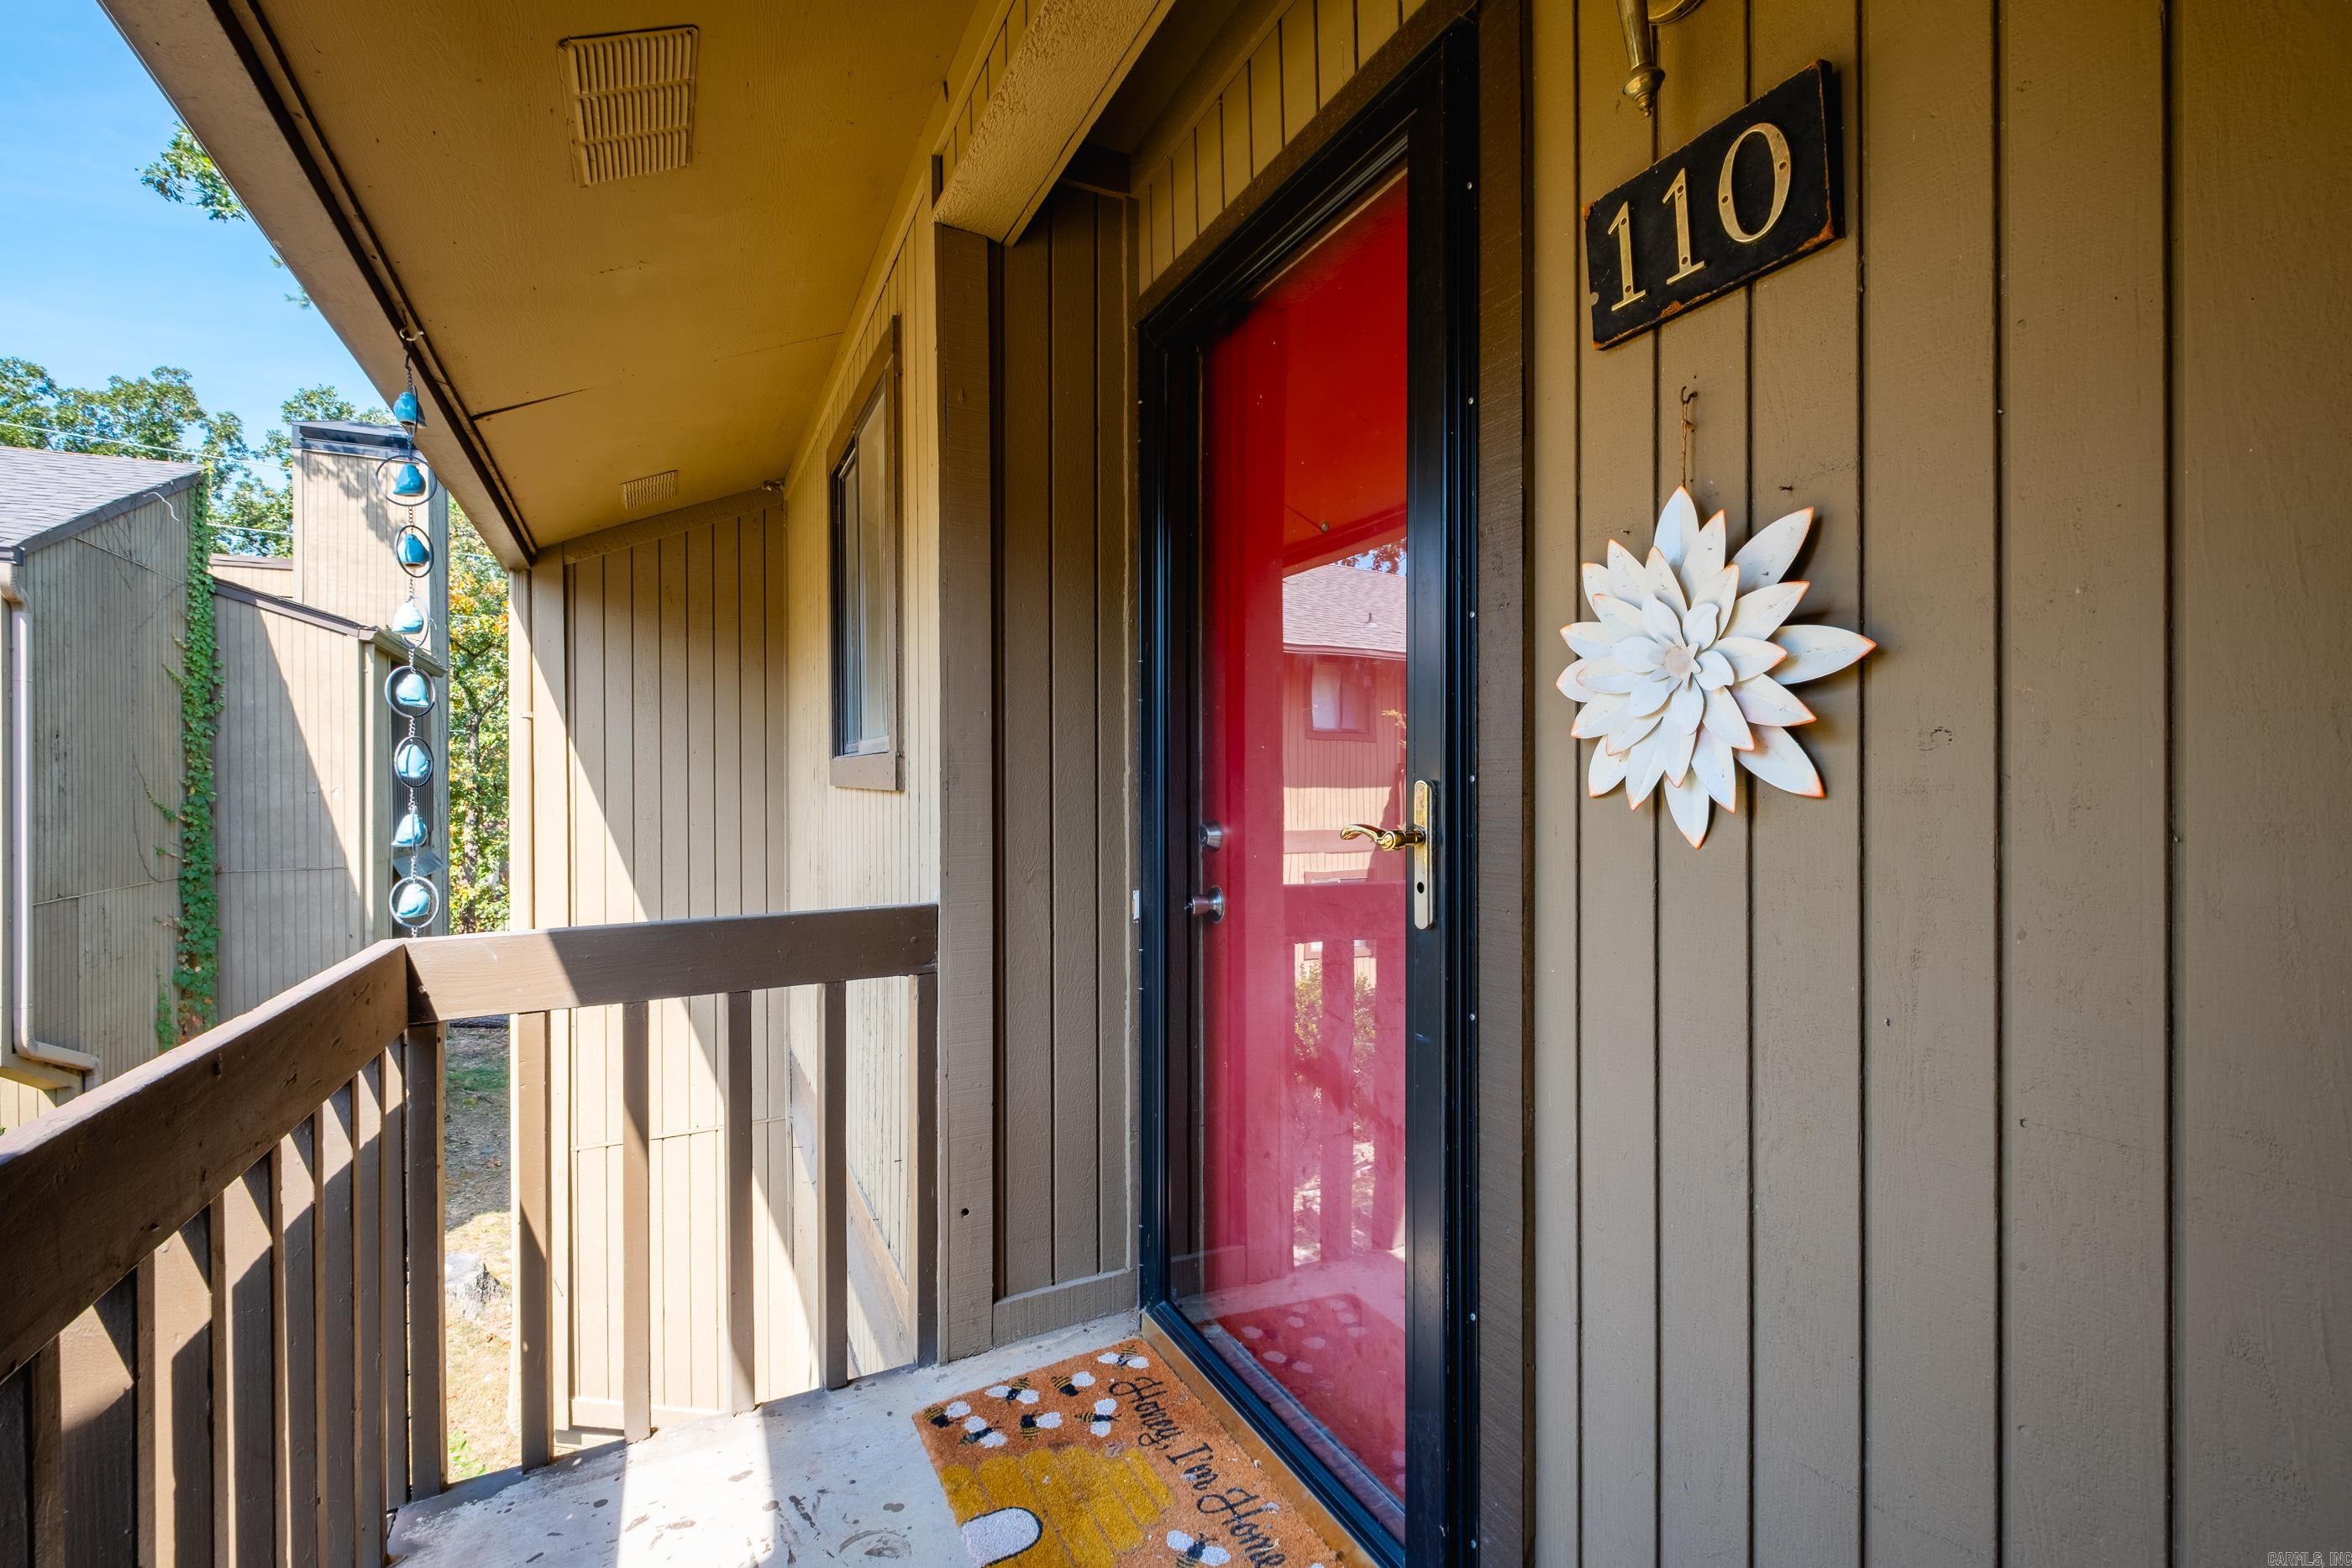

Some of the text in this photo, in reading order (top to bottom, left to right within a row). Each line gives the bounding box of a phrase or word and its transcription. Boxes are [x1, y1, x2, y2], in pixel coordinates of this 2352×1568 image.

[1608, 123, 1792, 312] 110
[1109, 1377, 1286, 1568] Honey, I'm Home
